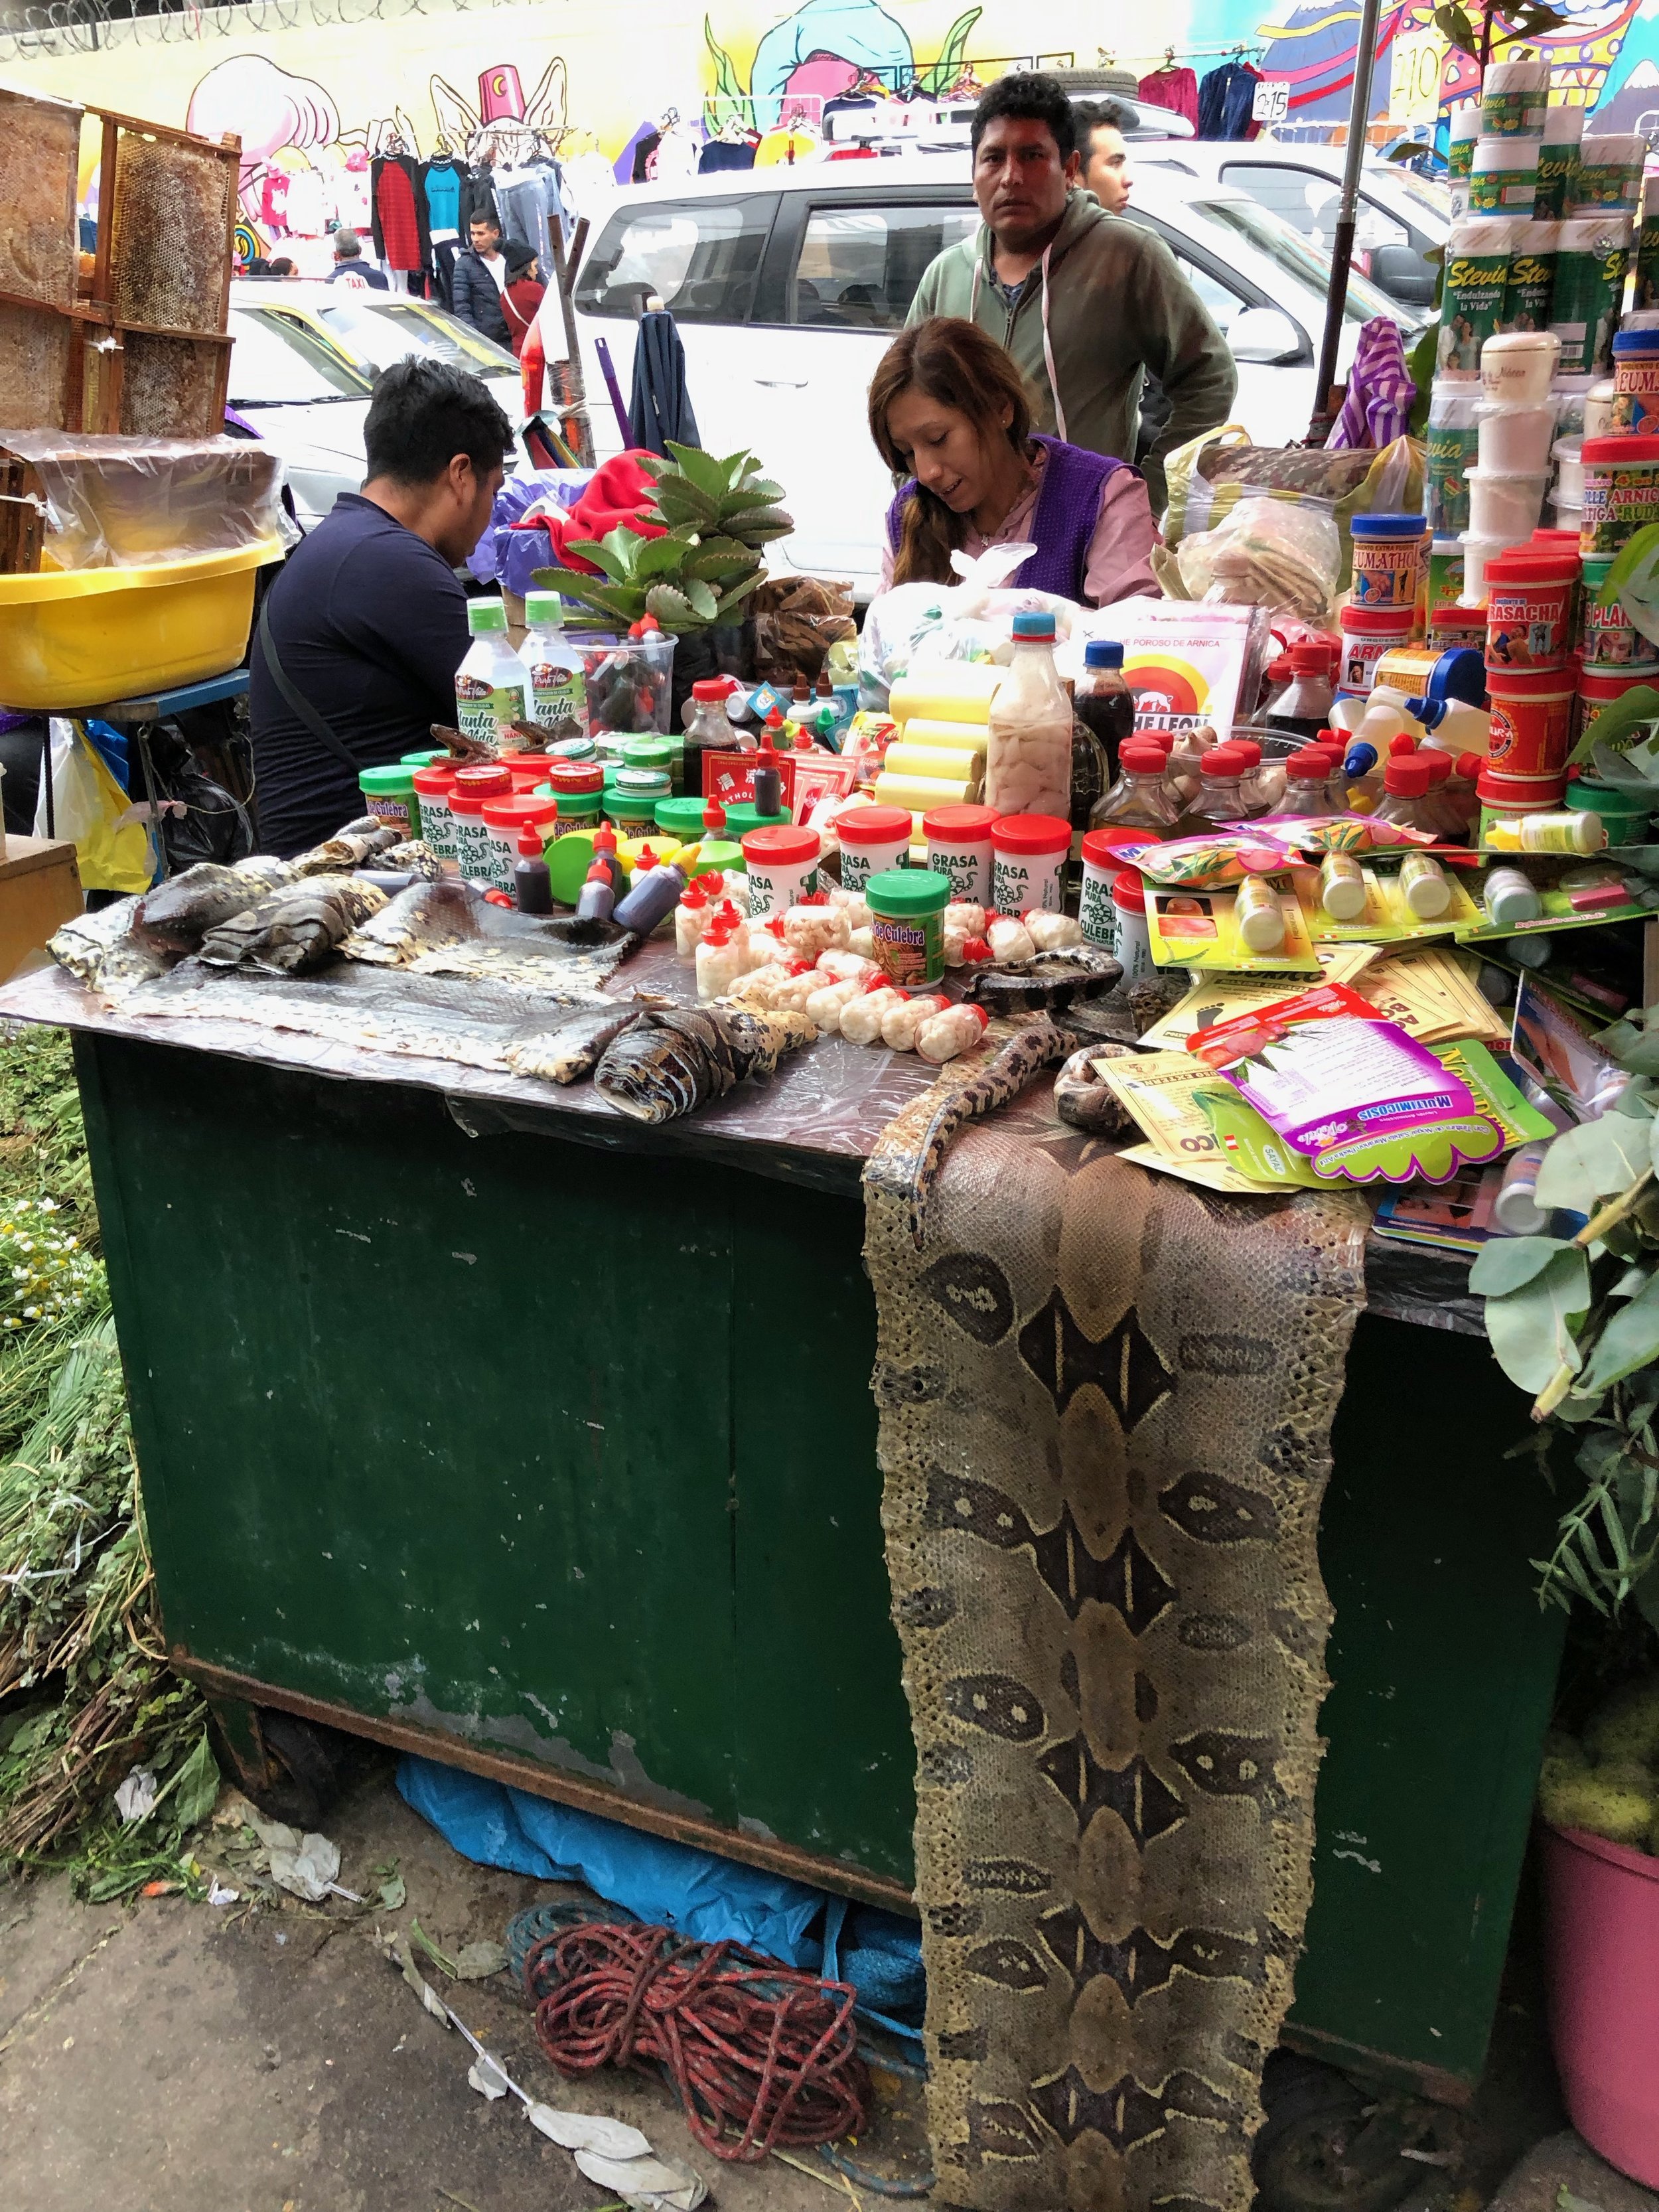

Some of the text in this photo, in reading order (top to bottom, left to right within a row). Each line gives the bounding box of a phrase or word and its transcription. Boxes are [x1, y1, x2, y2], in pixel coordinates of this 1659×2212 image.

[1447, 261, 1507, 287] Stevia
[345, 278, 366, 289] TAXI
[1611, 488, 1659, 504] ARNIC
[1623, 505, 1659, 522] RUD
[1133, 638, 1171, 647] POROSO
[534, 697, 576, 714] lanta
[459, 710, 498, 729] lanta
[376, 802, 409, 818] Culebra
[419, 804, 453, 818] GRASA
[433, 845, 458, 855] EBRA
[490, 841, 512, 853] ASA
[840, 851, 871, 869] RASA
[932, 853, 978, 868] GRASA
[933, 865, 954, 877] PURA
[495, 881, 516, 893] EBRA
[747, 873, 773, 891] RASA
[1084, 876, 1114, 899] GRA
[1084, 891, 1102, 905] PURA
[875, 924, 925, 946] de Culebra
[1080, 919, 1115, 941] CULEBR
[1144, 1074, 1194, 1086] EXTERN
[1194, 1070, 1221, 1079] USO
[1358, 1095, 1453, 1121] MULTIMICOSIS
[1388, 1130, 1411, 1143] Sabila
[1411, 1127, 1433, 1138] Nogal
[1319, 1156, 1334, 1167] Azul
